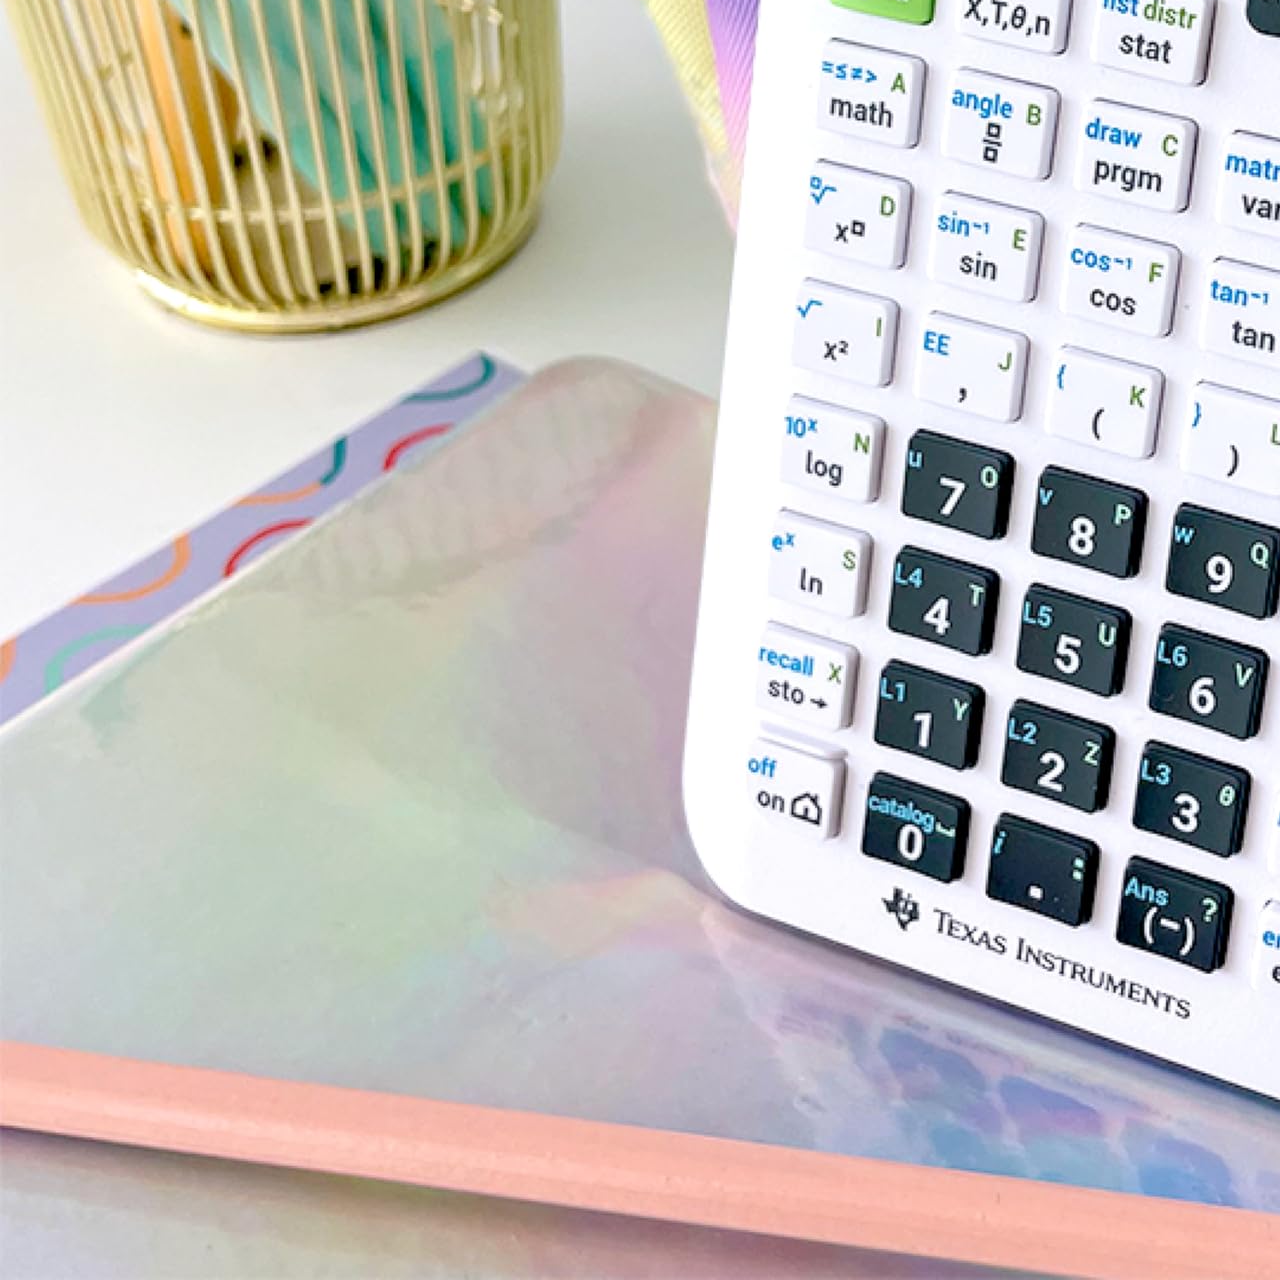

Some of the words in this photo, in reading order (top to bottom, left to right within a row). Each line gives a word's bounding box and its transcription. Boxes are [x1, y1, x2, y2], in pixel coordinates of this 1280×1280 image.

[1143, 0, 1199, 32] distr
[1119, 34, 1172, 64] stat
[891, 73, 906, 94] A
[830, 98, 892, 129] math
[951, 88, 1014, 120] angle
[1026, 104, 1041, 125] B
[1084, 117, 1142, 149] draw
[1162, 133, 1179, 157] C
[1093, 160, 1162, 193] prgm
[881, 196, 896, 216] D
[1012, 228, 1027, 251] E
[959, 252, 997, 281] sin
[1148, 261, 1163, 283] F
[1089, 288, 1136, 316] cos
[922, 329, 951, 357] EE
[1232, 321, 1276, 353] tan
[998, 352, 1012, 372] J
[1129, 385, 1146, 408] K
[1092, 408, 1105, 440] (
[853, 432, 870, 455] N
[806, 450, 842, 487] log
[908, 450, 922, 468] u
[1227, 444, 1239, 477] )
[939, 477, 966, 516] 7
[1114, 503, 1132, 525] P
[1068, 517, 1096, 556] 8
[842, 549, 857, 572] S
[1250, 542, 1269, 569] Q
[800, 567, 823, 595] ln
[894, 562, 923, 588] L4
[1207, 555, 1233, 593] 9
[969, 584, 985, 607] T
[923, 597, 951, 635] 4
[1022, 601, 1053, 627] L5
[1098, 622, 1117, 647] U
[758, 647, 815, 677] recall
[1054, 634, 1082, 674] 5
[1157, 640, 1187, 667] L6
[827, 663, 843, 684] X
[1236, 662, 1253, 687] V
[769, 681, 804, 705] sto
[880, 677, 907, 702] L1
[1189, 677, 1215, 715] 6
[953, 698, 970, 721] Y
[913, 712, 932, 748] 1
[1008, 717, 1037, 745] L2
[747, 756, 777, 779] off
[1084, 741, 1101, 766] Z
[1037, 752, 1065, 793] 2
[1141, 759, 1171, 785] L3
[757, 790, 785, 813] on
[868, 795, 936, 833] catalog
[1172, 793, 1200, 833] 3
[898, 823, 925, 861] 0
[1124, 877, 1169, 906] Ans
[1202, 897, 1217, 922] ?
[933, 908, 1007, 955] TEXAS
[1016, 937, 1191, 1020] INSTRUMENTS
